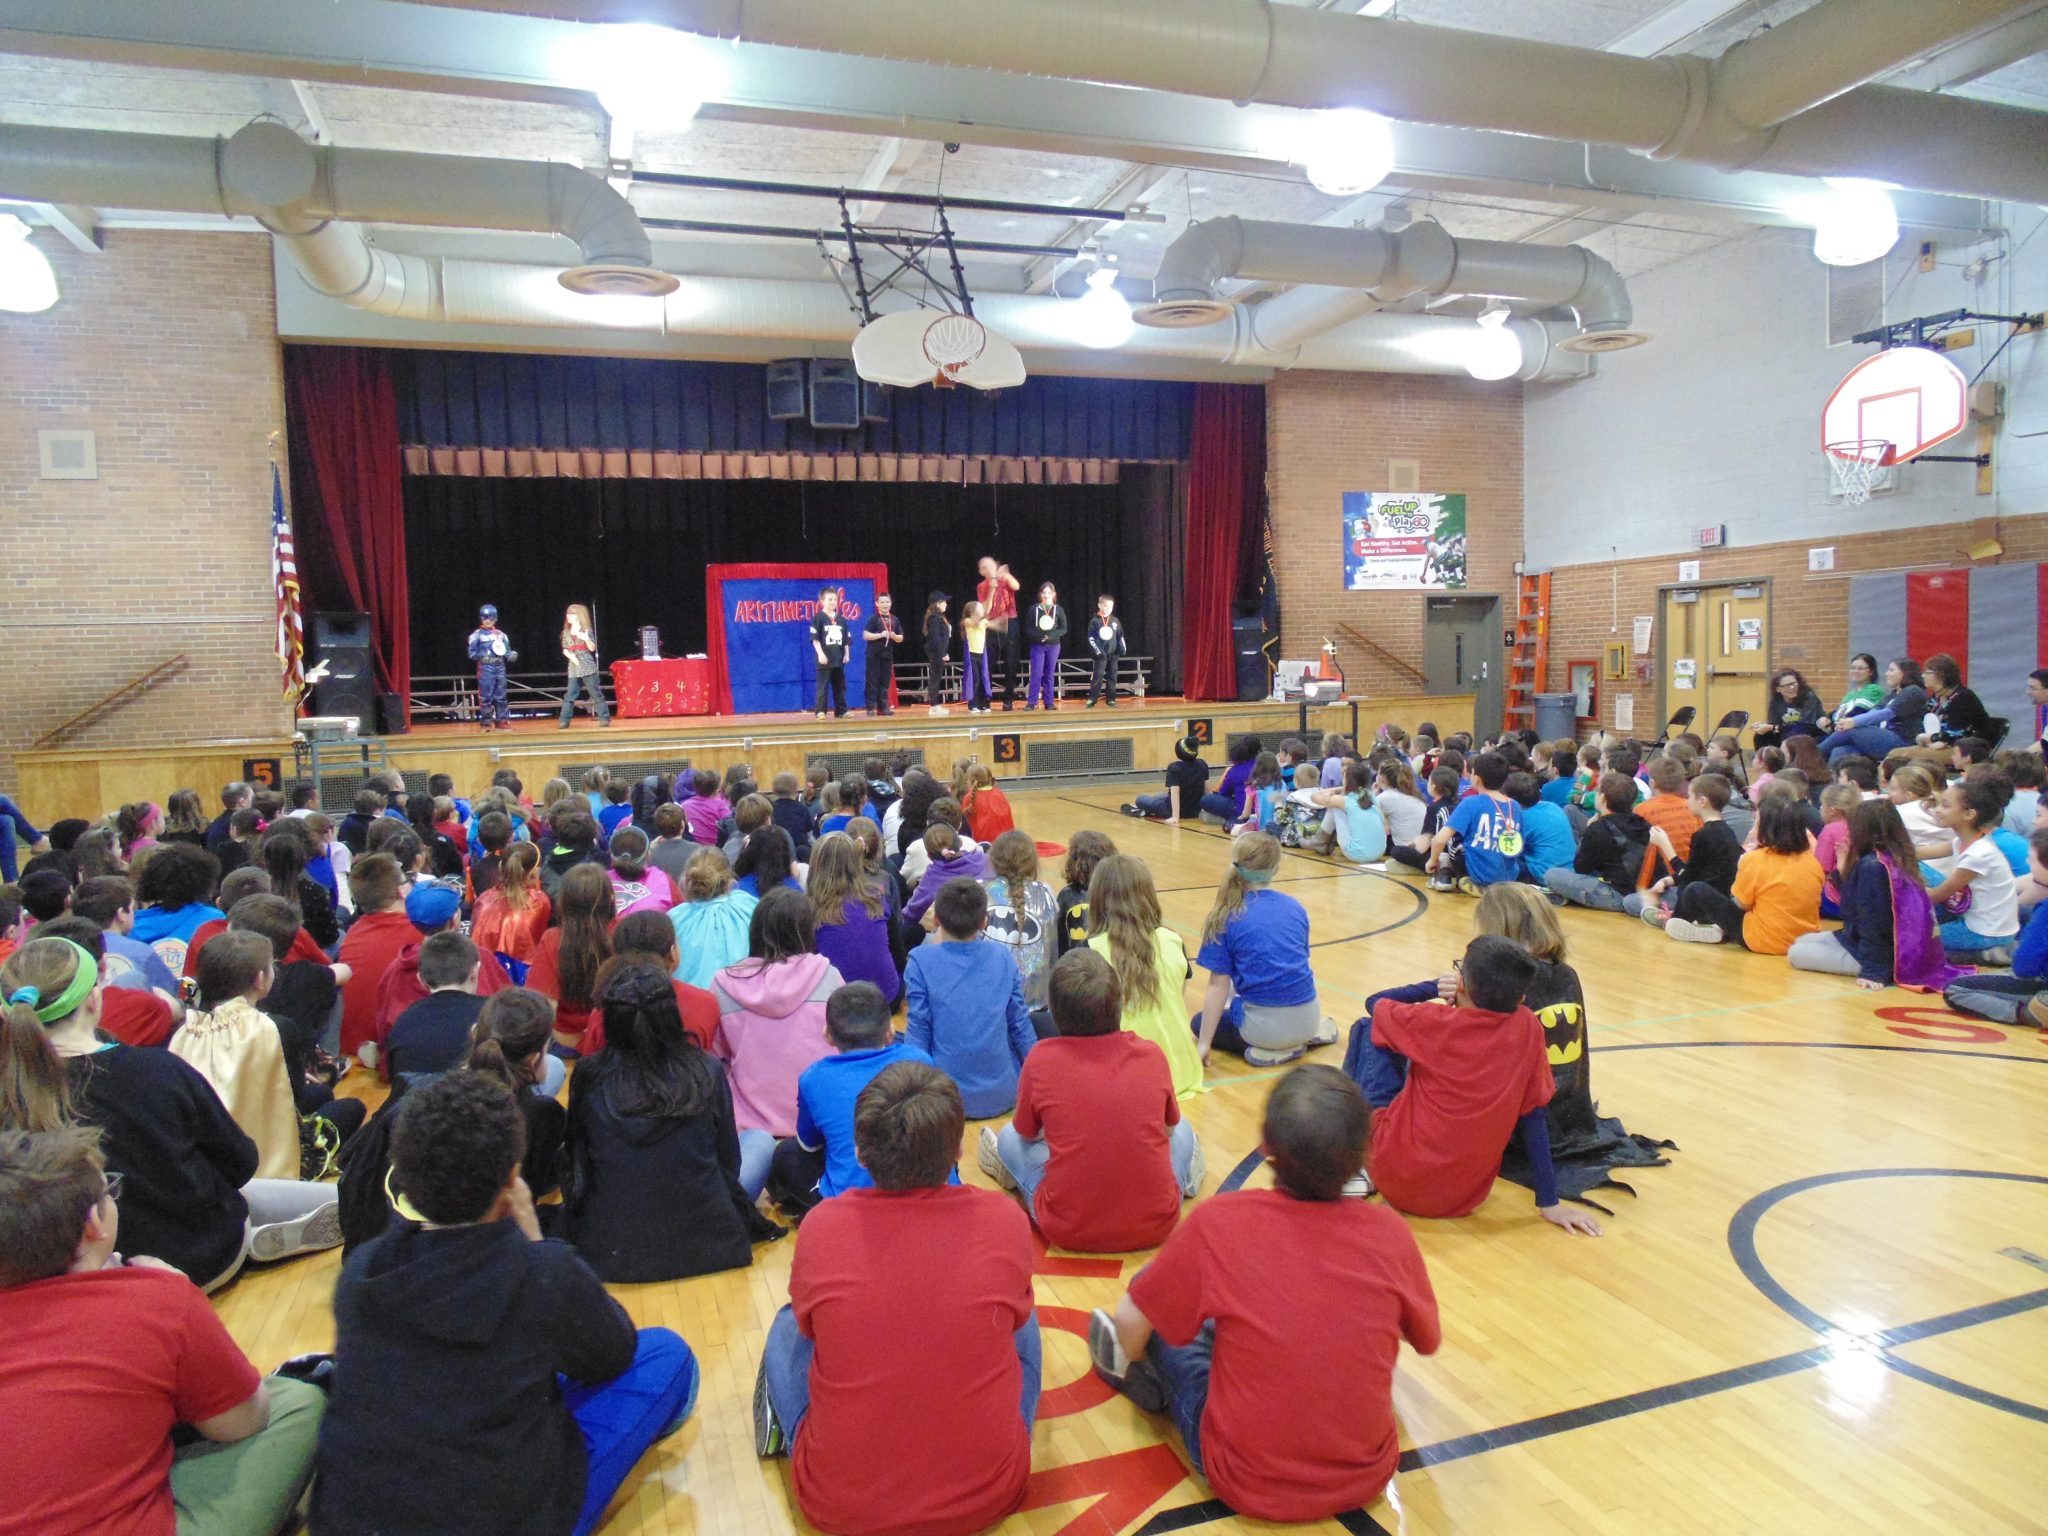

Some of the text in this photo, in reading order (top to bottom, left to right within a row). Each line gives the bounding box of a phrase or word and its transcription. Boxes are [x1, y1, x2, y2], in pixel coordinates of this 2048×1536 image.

[1381, 505, 1405, 515] FUEL
[1193, 721, 1208, 742] 2
[1000, 737, 1015, 760] 3
[252, 762, 273, 786] 5
